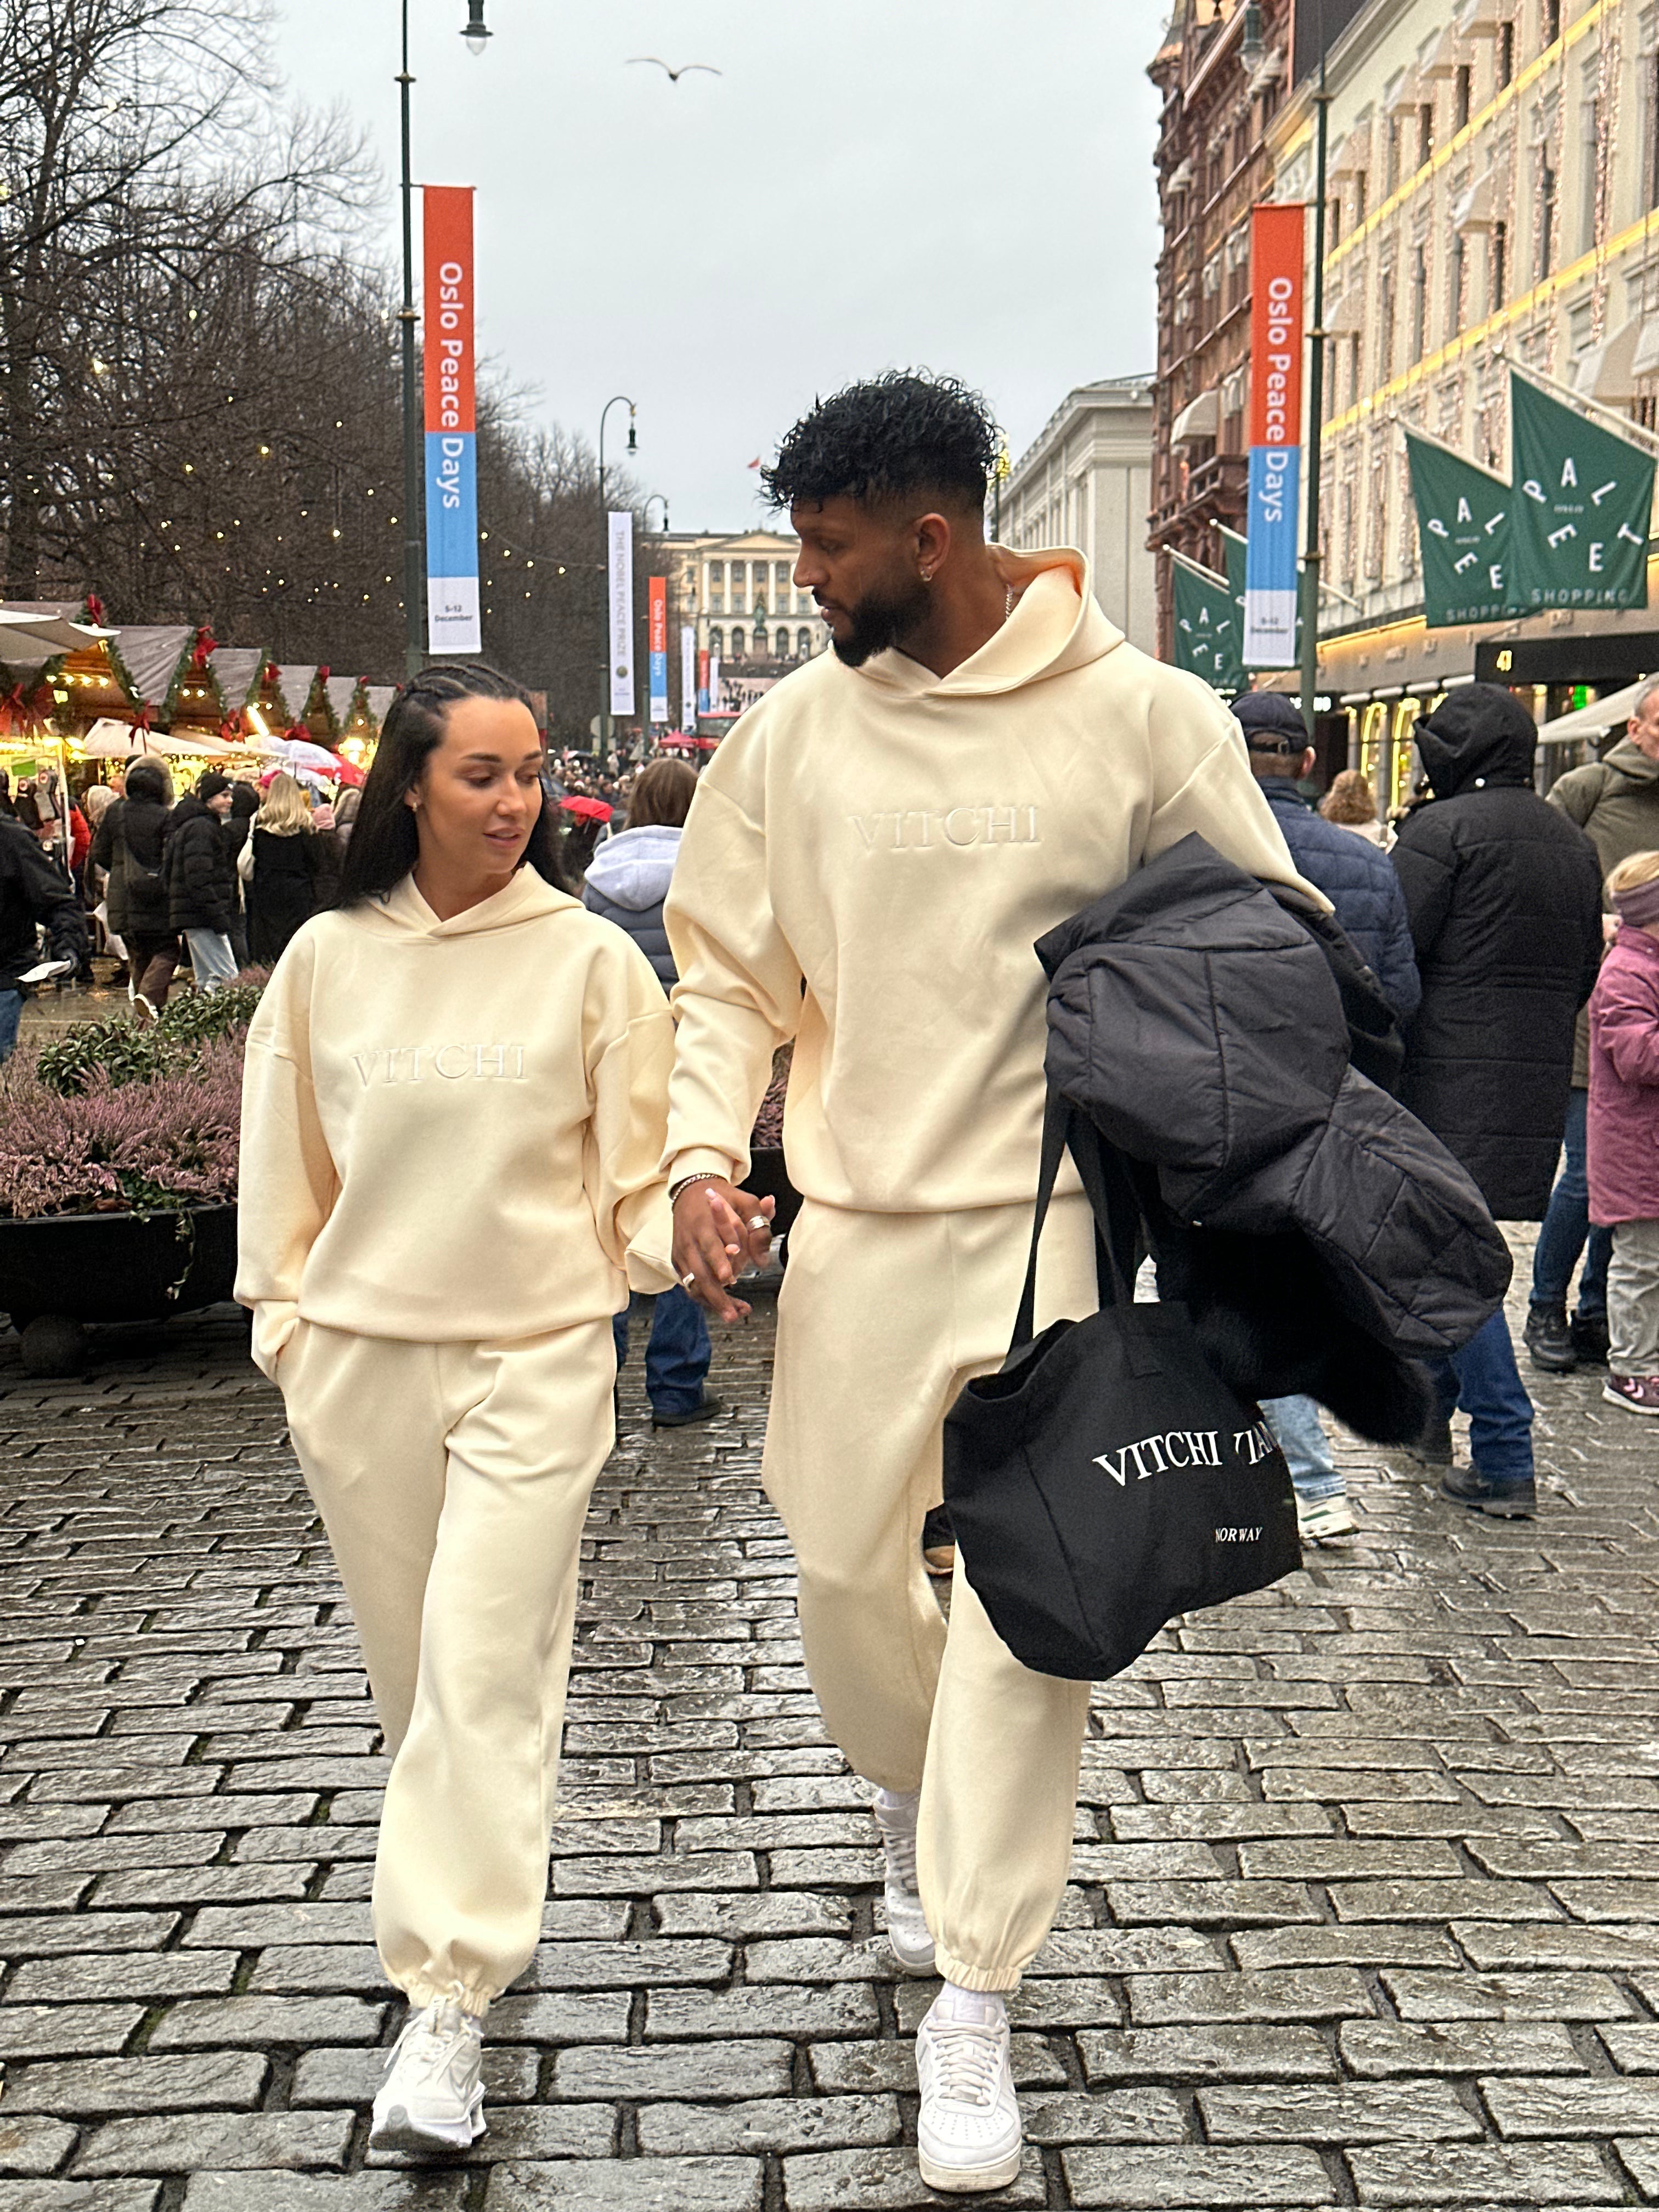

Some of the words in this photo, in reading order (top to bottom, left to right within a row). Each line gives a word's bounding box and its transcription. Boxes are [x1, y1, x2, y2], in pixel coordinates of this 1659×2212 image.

[439, 261, 464, 329] Oslo
[1267, 276, 1294, 346] Oslo
[439, 339, 463, 427] Peace
[1266, 353, 1291, 442] Peace
[436, 438, 464, 509] Days
[1259, 451, 1289, 523] Days
[616, 530, 625, 551] THE
[615, 553, 625, 590] NOBEL
[1531, 588, 1629, 603] SHOPPING
[616, 591, 625, 625] PEACE
[617, 628, 626, 657] PRIZE
[847, 806, 1041, 854] VITCHI
[351, 1043, 528, 1087] VITCHI
[1092, 1430, 1223, 1487] VITCHI
[1215, 1527, 1263, 1543] NORWAY
